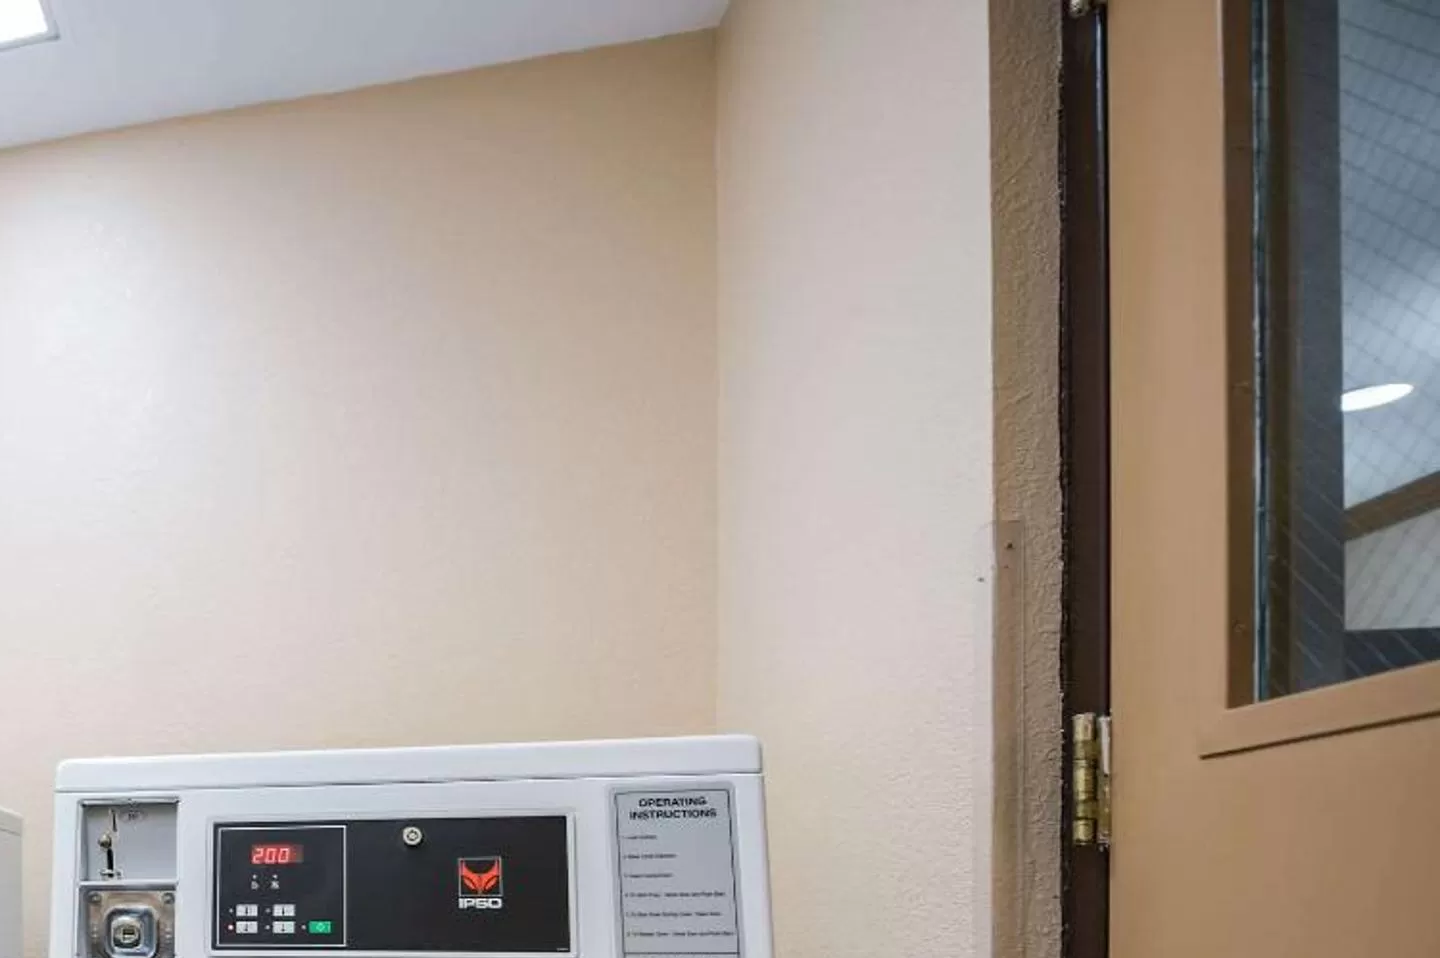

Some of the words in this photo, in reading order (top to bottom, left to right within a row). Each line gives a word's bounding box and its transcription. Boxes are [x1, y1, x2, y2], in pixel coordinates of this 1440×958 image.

[638, 797, 708, 807] OPERATING
[628, 808, 717, 820] INSTRUCTIONS
[458, 898, 502, 909] IPSO
